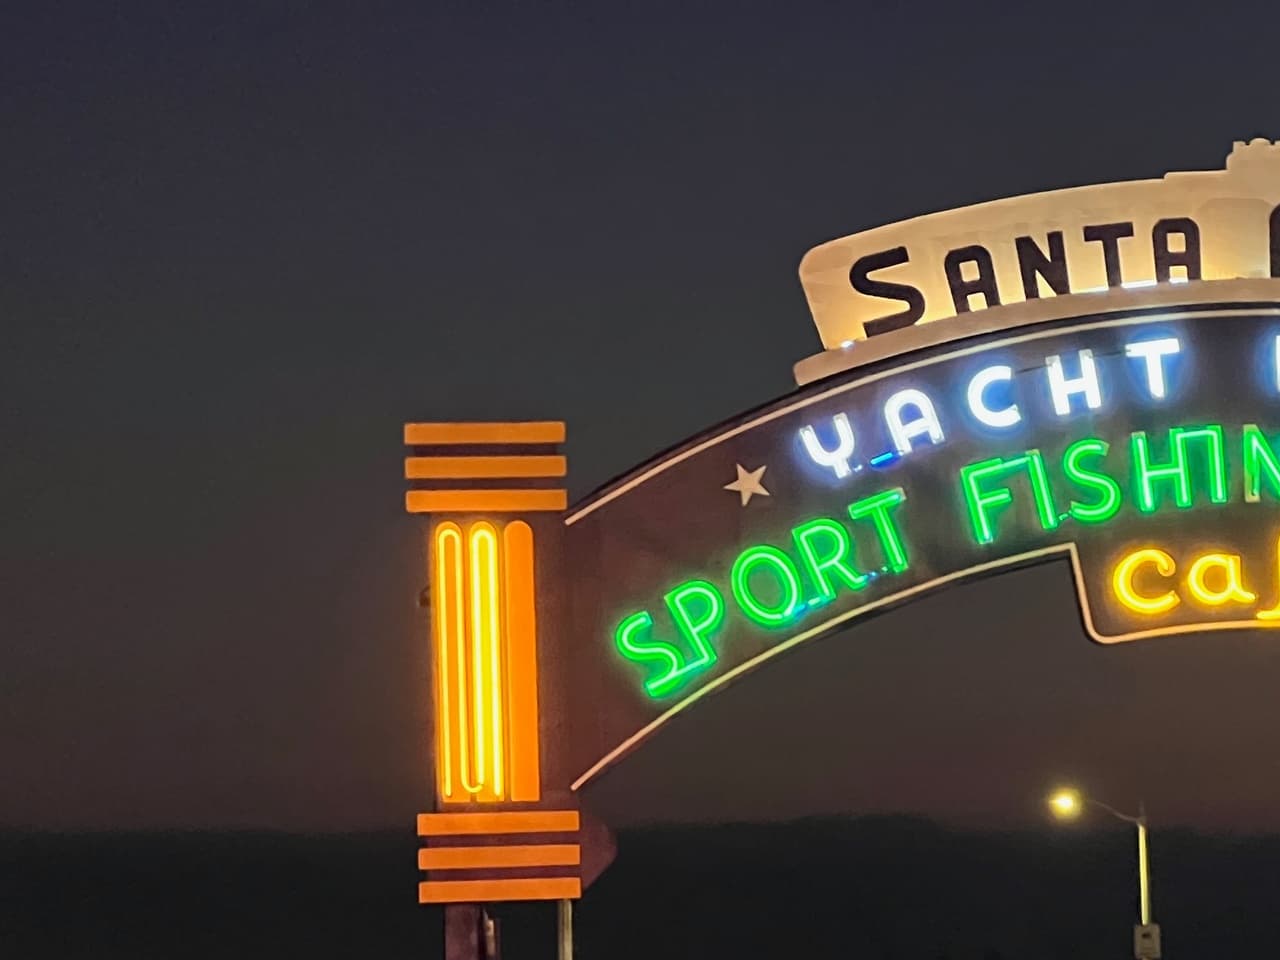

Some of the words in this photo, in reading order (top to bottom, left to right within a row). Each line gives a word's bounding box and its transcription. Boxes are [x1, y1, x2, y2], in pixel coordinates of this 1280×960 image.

[849, 217, 1201, 339] SANTA
[800, 338, 1183, 480] YACHT
[613, 487, 911, 698] SPORT
